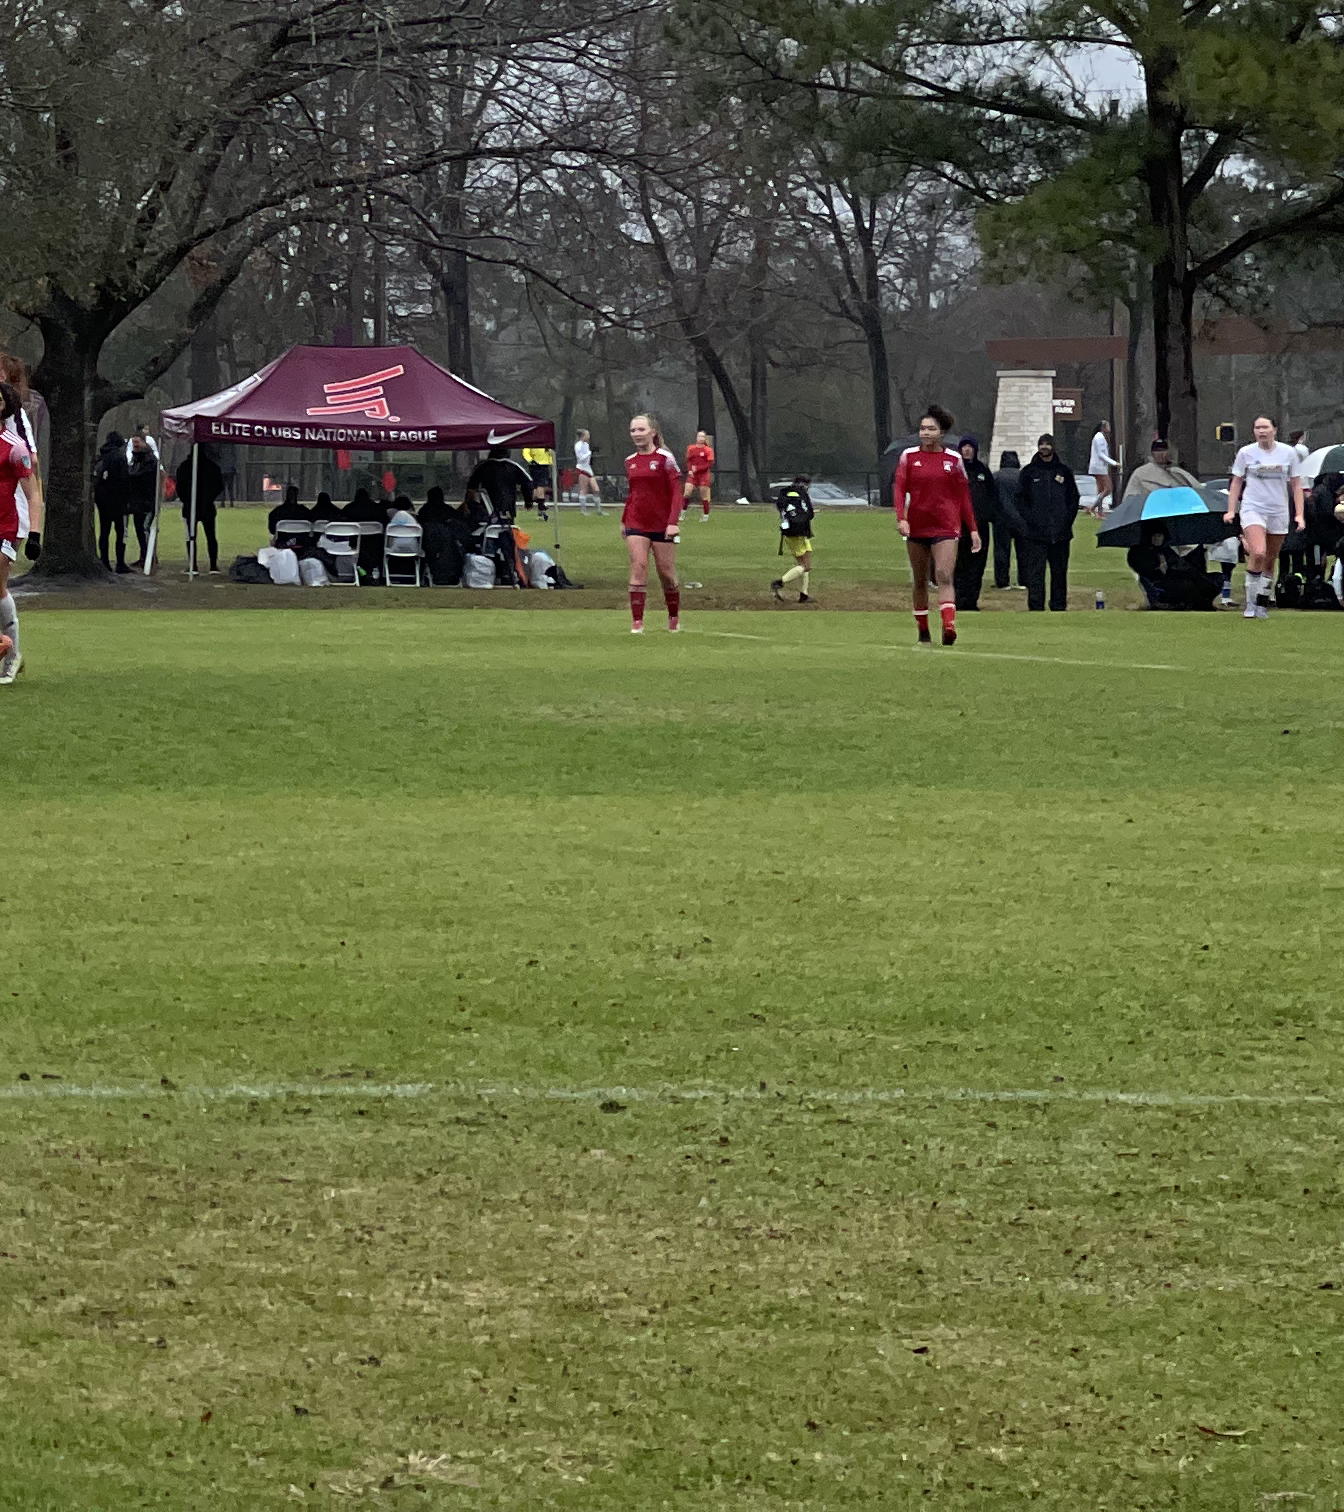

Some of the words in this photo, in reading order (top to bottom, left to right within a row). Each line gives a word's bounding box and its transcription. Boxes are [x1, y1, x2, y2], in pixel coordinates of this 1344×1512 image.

[211, 421, 251, 437] ELITE
[254, 425, 301, 440] CLUBS
[304, 427, 376, 442] NATIONAL
[380, 430, 438, 443] LEAGUE
